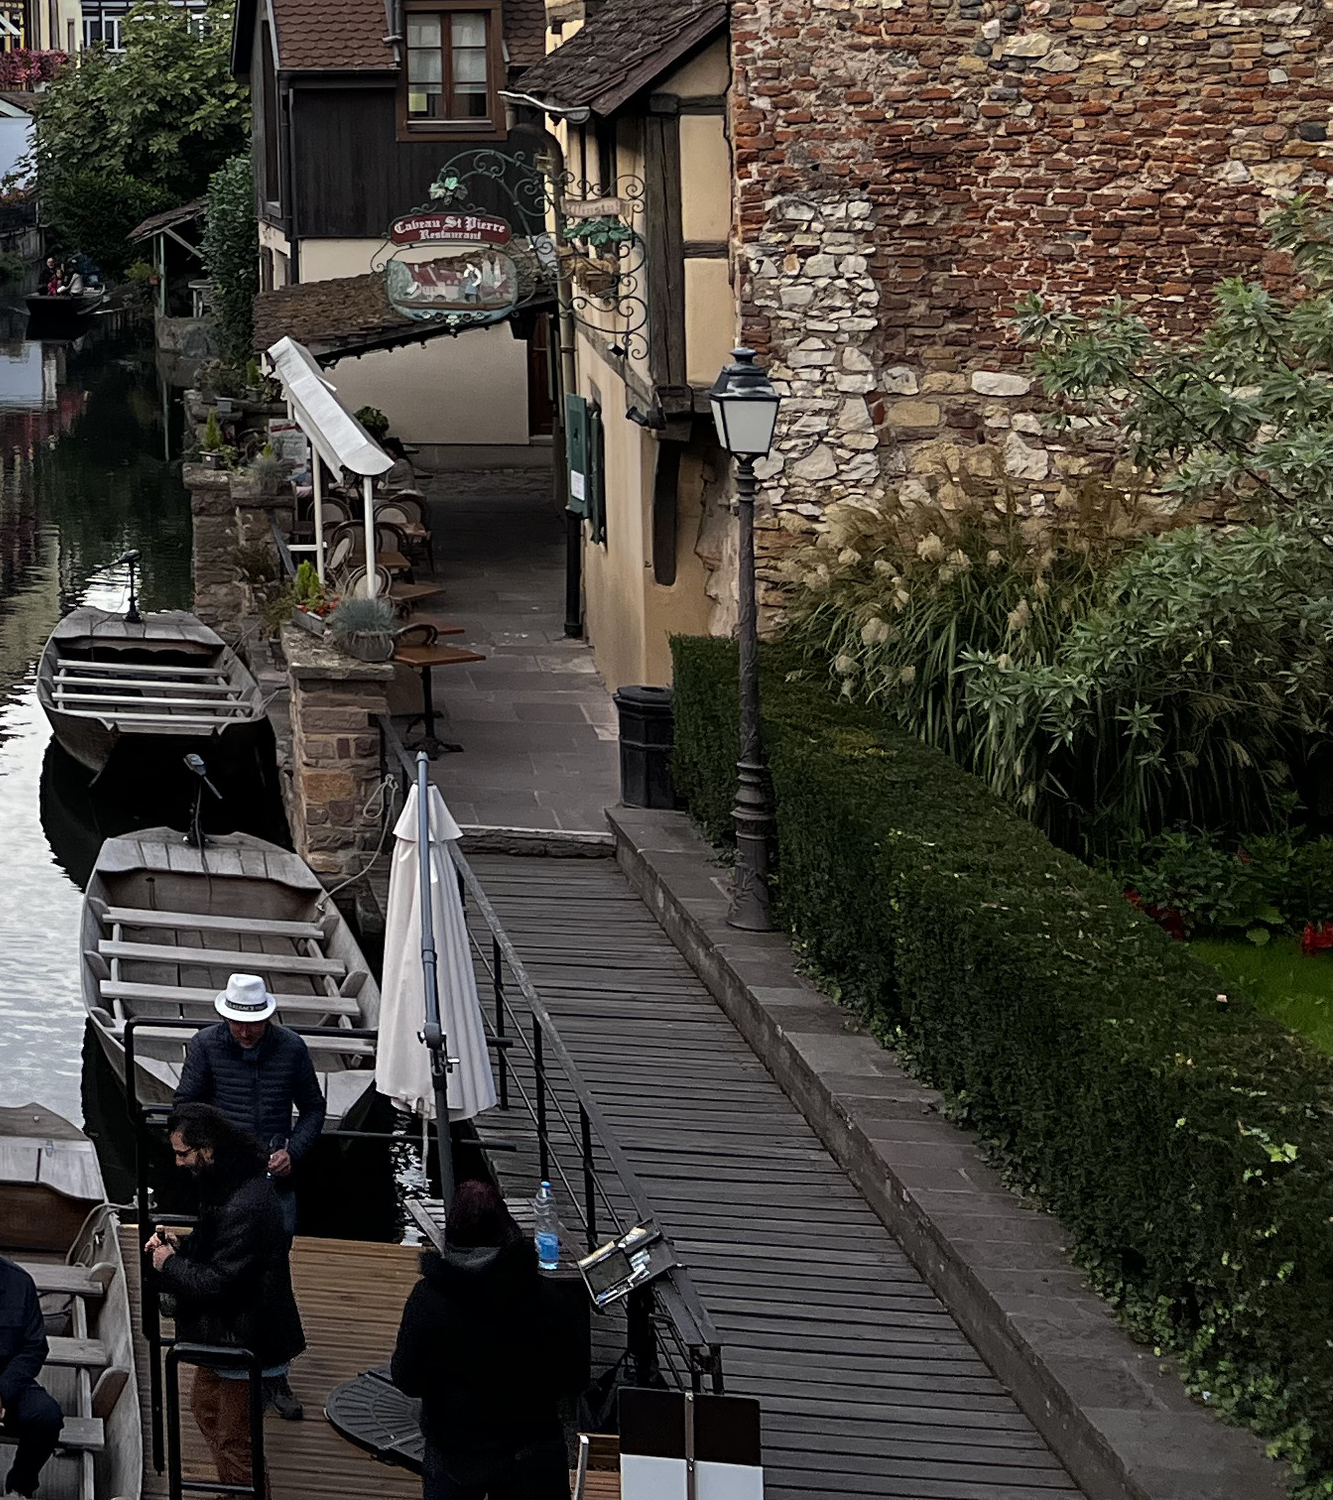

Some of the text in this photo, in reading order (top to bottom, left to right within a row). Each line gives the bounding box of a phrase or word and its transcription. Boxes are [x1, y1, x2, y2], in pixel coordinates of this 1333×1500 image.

[443, 216, 462, 230] St
[465, 216, 506, 233] Pierre
[419, 229, 482, 240] Restaurant
